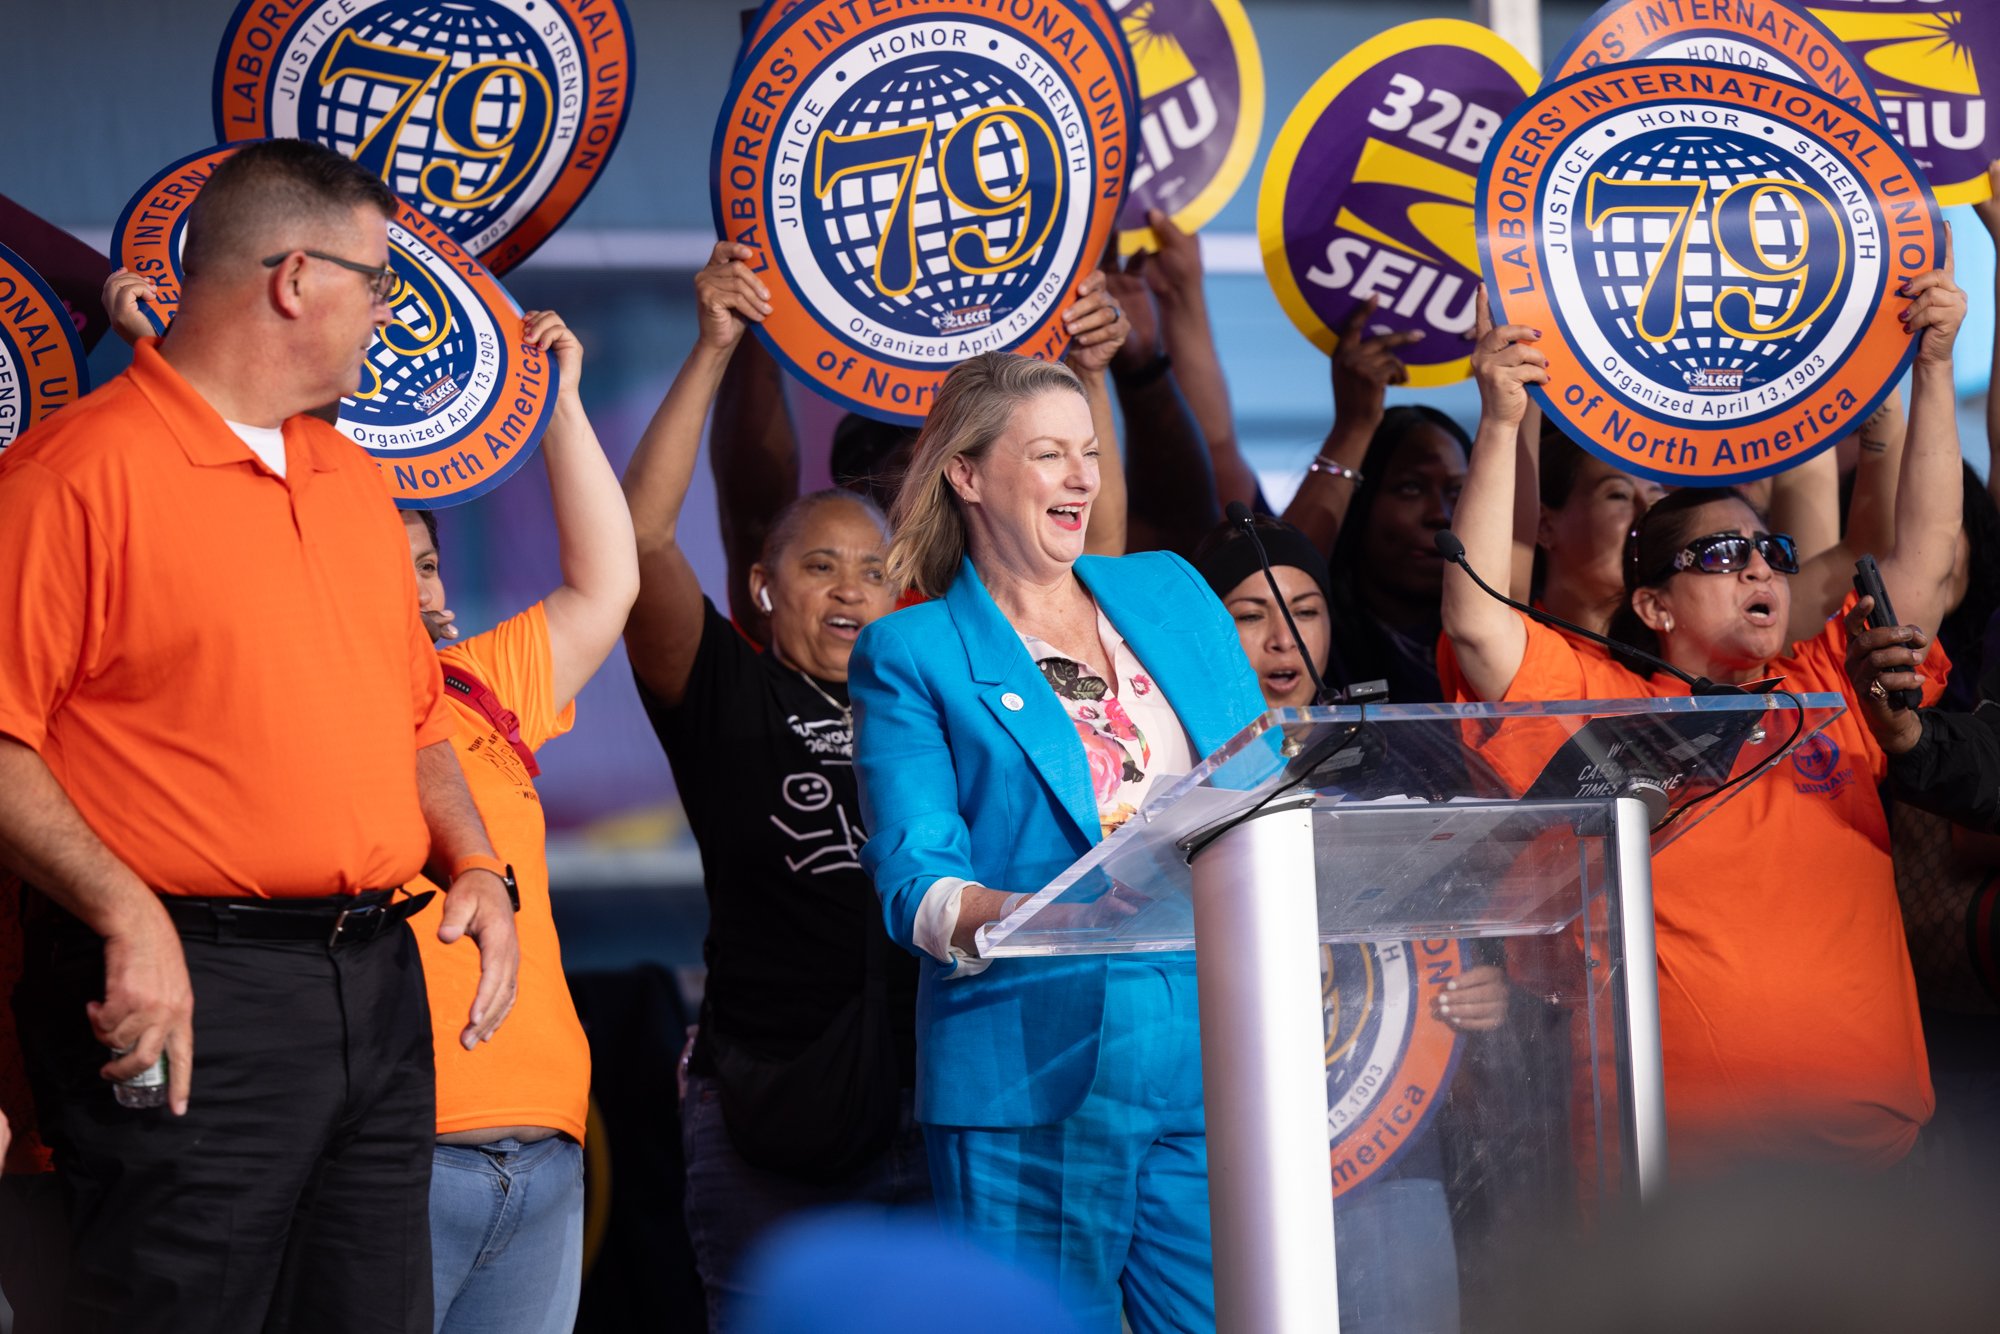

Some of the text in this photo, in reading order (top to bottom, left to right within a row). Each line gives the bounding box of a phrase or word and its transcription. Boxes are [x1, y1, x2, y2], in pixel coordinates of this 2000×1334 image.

[279, 1, 356, 100] JUSTICE
[542, 20, 578, 140] STRENGTH
[868, 28, 967, 63] HONOR
[1687, 44, 1768, 71] HONOR
[318, 27, 554, 210] 79
[575, 60, 620, 171] UNION
[729, 0, 1122, 274] LABORERS' INTEONAL UNION
[778, 98, 824, 228] JUSTICE
[1015, 52, 1087, 174] STRENGTH
[1637, 109, 1739, 128] HONOR
[133, 157, 228, 247] INTERNA
[814, 104, 1063, 297] 79
[1498, 72, 1926, 300] LABORERS' INTERNATIONAL UNION
[1549, 145, 1595, 254] JUSTICE
[1793, 140, 1877, 260] STRENGTH
[1305, 237, 1478, 334] SEIU
[1585, 171, 1847, 343] 79
[816, 350, 857, 381] of
[849, 317, 949, 357] Organized
[957, 329, 1003, 358] April
[1603, 356, 1693, 414] Organized
[1701, 396, 1750, 418] April
[1708, 375, 1743, 386] LECET
[353, 419, 445, 447] Organized
[447, 391, 480, 427] April
[394, 342, 543, 490] North America
[1564, 383, 1605, 418] of
[1601, 409, 1698, 467] North
[1711, 387, 1858, 467] America
